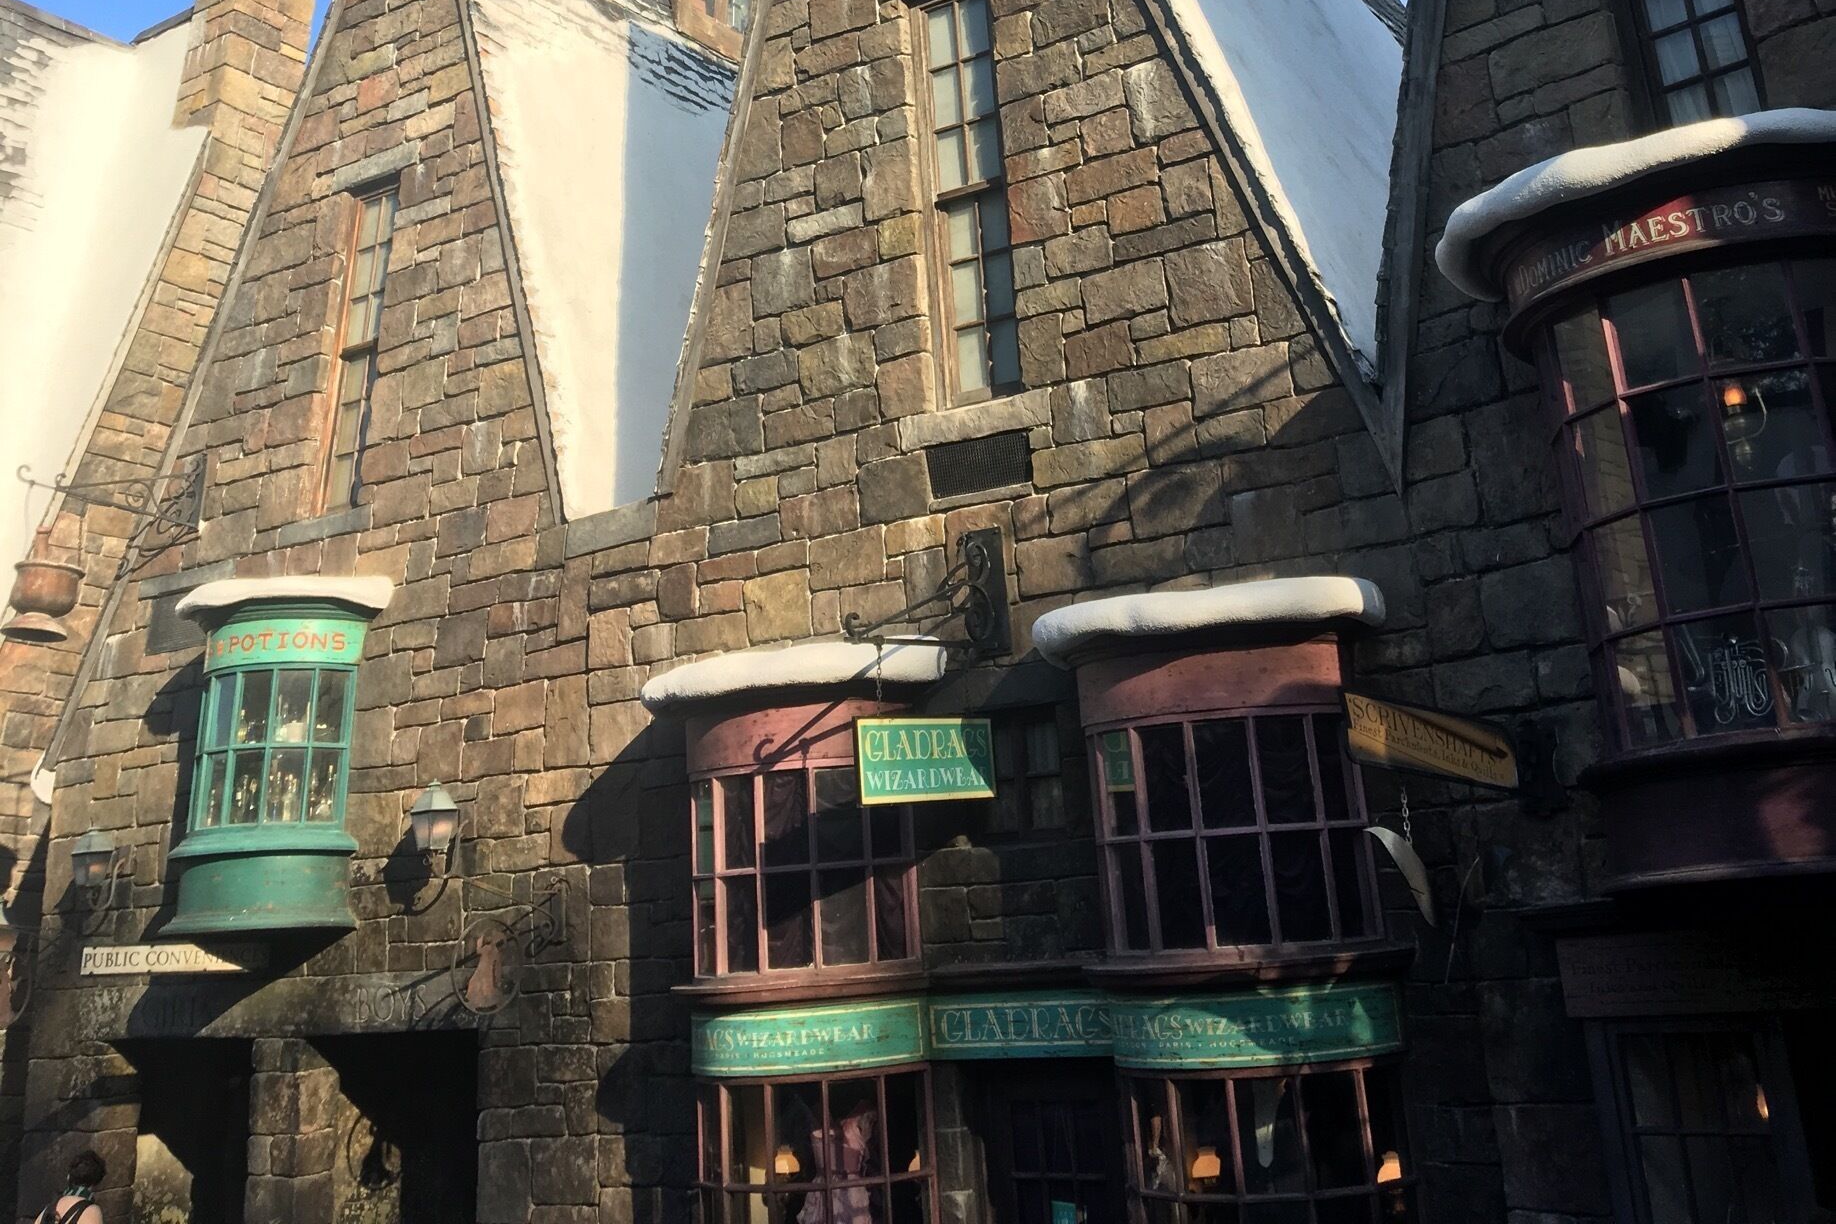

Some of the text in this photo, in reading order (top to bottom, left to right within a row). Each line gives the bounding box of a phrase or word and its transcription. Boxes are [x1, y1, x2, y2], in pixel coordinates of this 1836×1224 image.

[1517, 191, 1787, 295] DOMINIC MAESTRO'S
[228, 630, 347, 654] POTIONS
[864, 728, 988, 762] GLADRAGS
[83, 950, 141, 968] PUBLIC
[354, 983, 427, 1022] BOYS
[735, 1022, 875, 1050] WIZARDWEAR
[940, 1005, 1114, 1043] GLADRAGS
[753, 1049, 826, 1060] HOGSMEADE
[1158, 1040, 1192, 1049] PARIS
